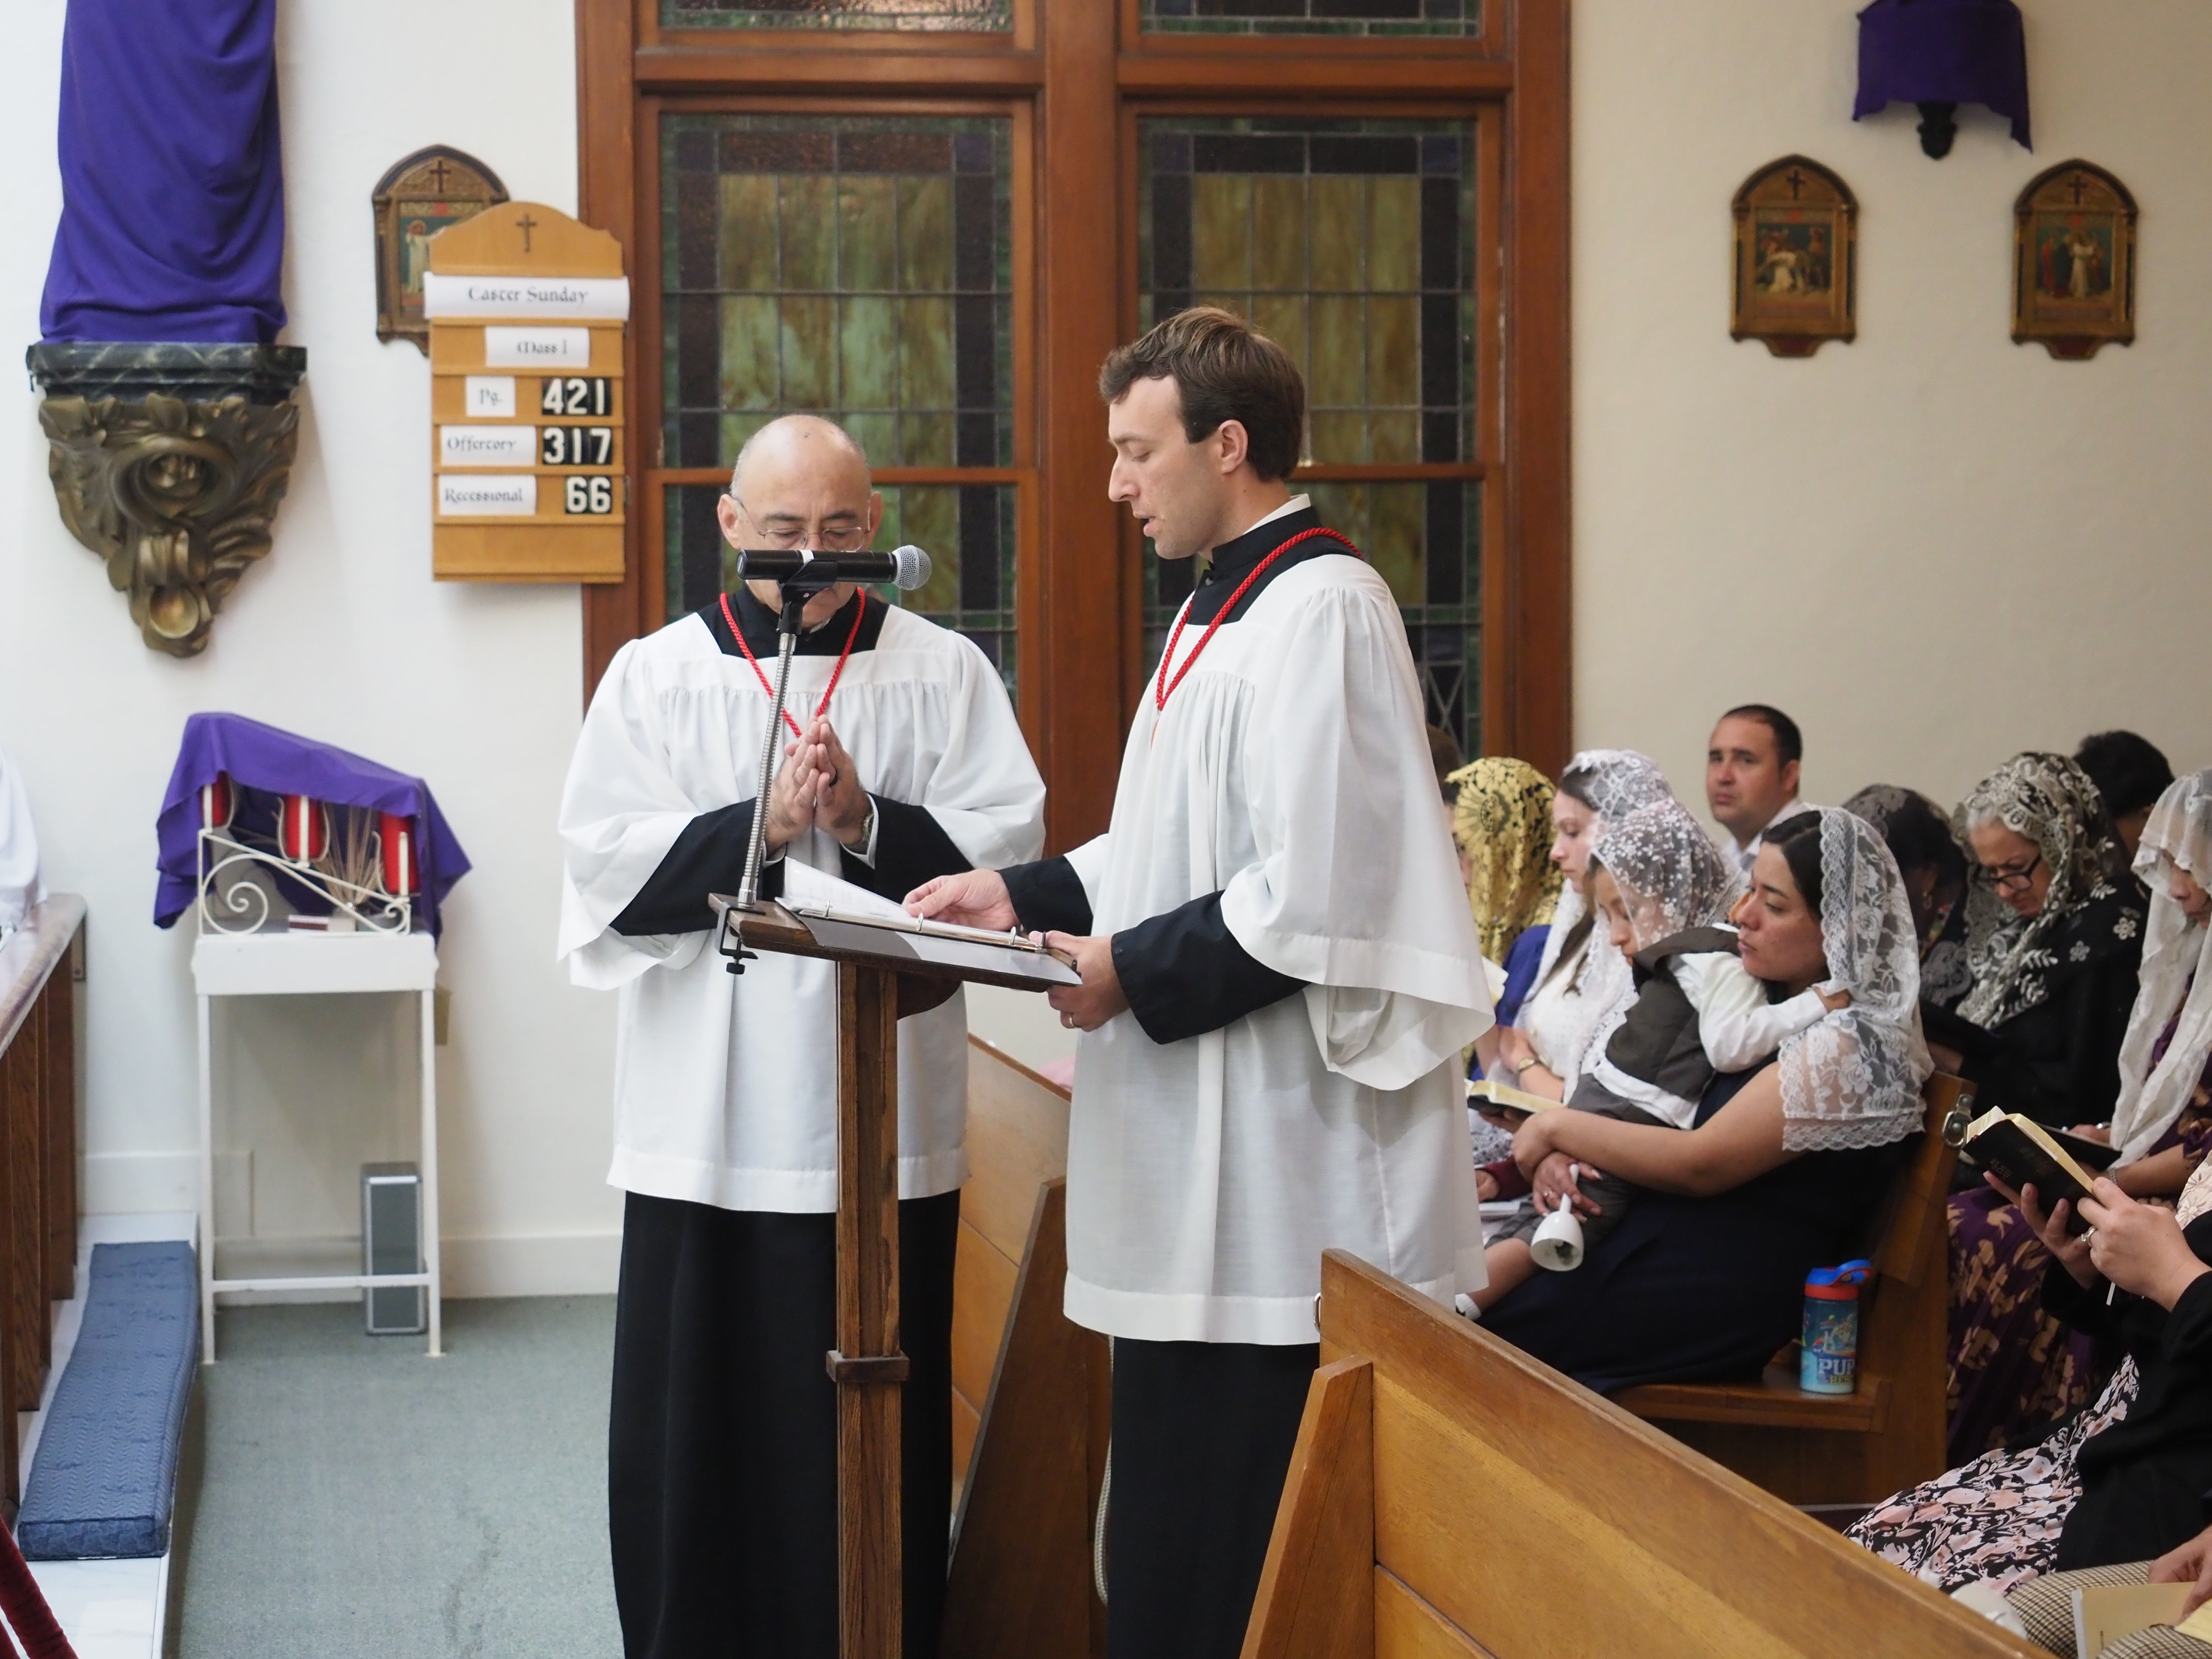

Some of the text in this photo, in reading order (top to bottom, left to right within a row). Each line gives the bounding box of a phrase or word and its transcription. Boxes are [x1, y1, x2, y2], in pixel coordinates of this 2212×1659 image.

[468, 285, 588, 304] Easter Sunday
[517, 340, 558, 354] Mass
[543, 378, 605, 415] 421
[447, 427, 611, 464] Offertory 317
[445, 476, 611, 513] Recessional 66
